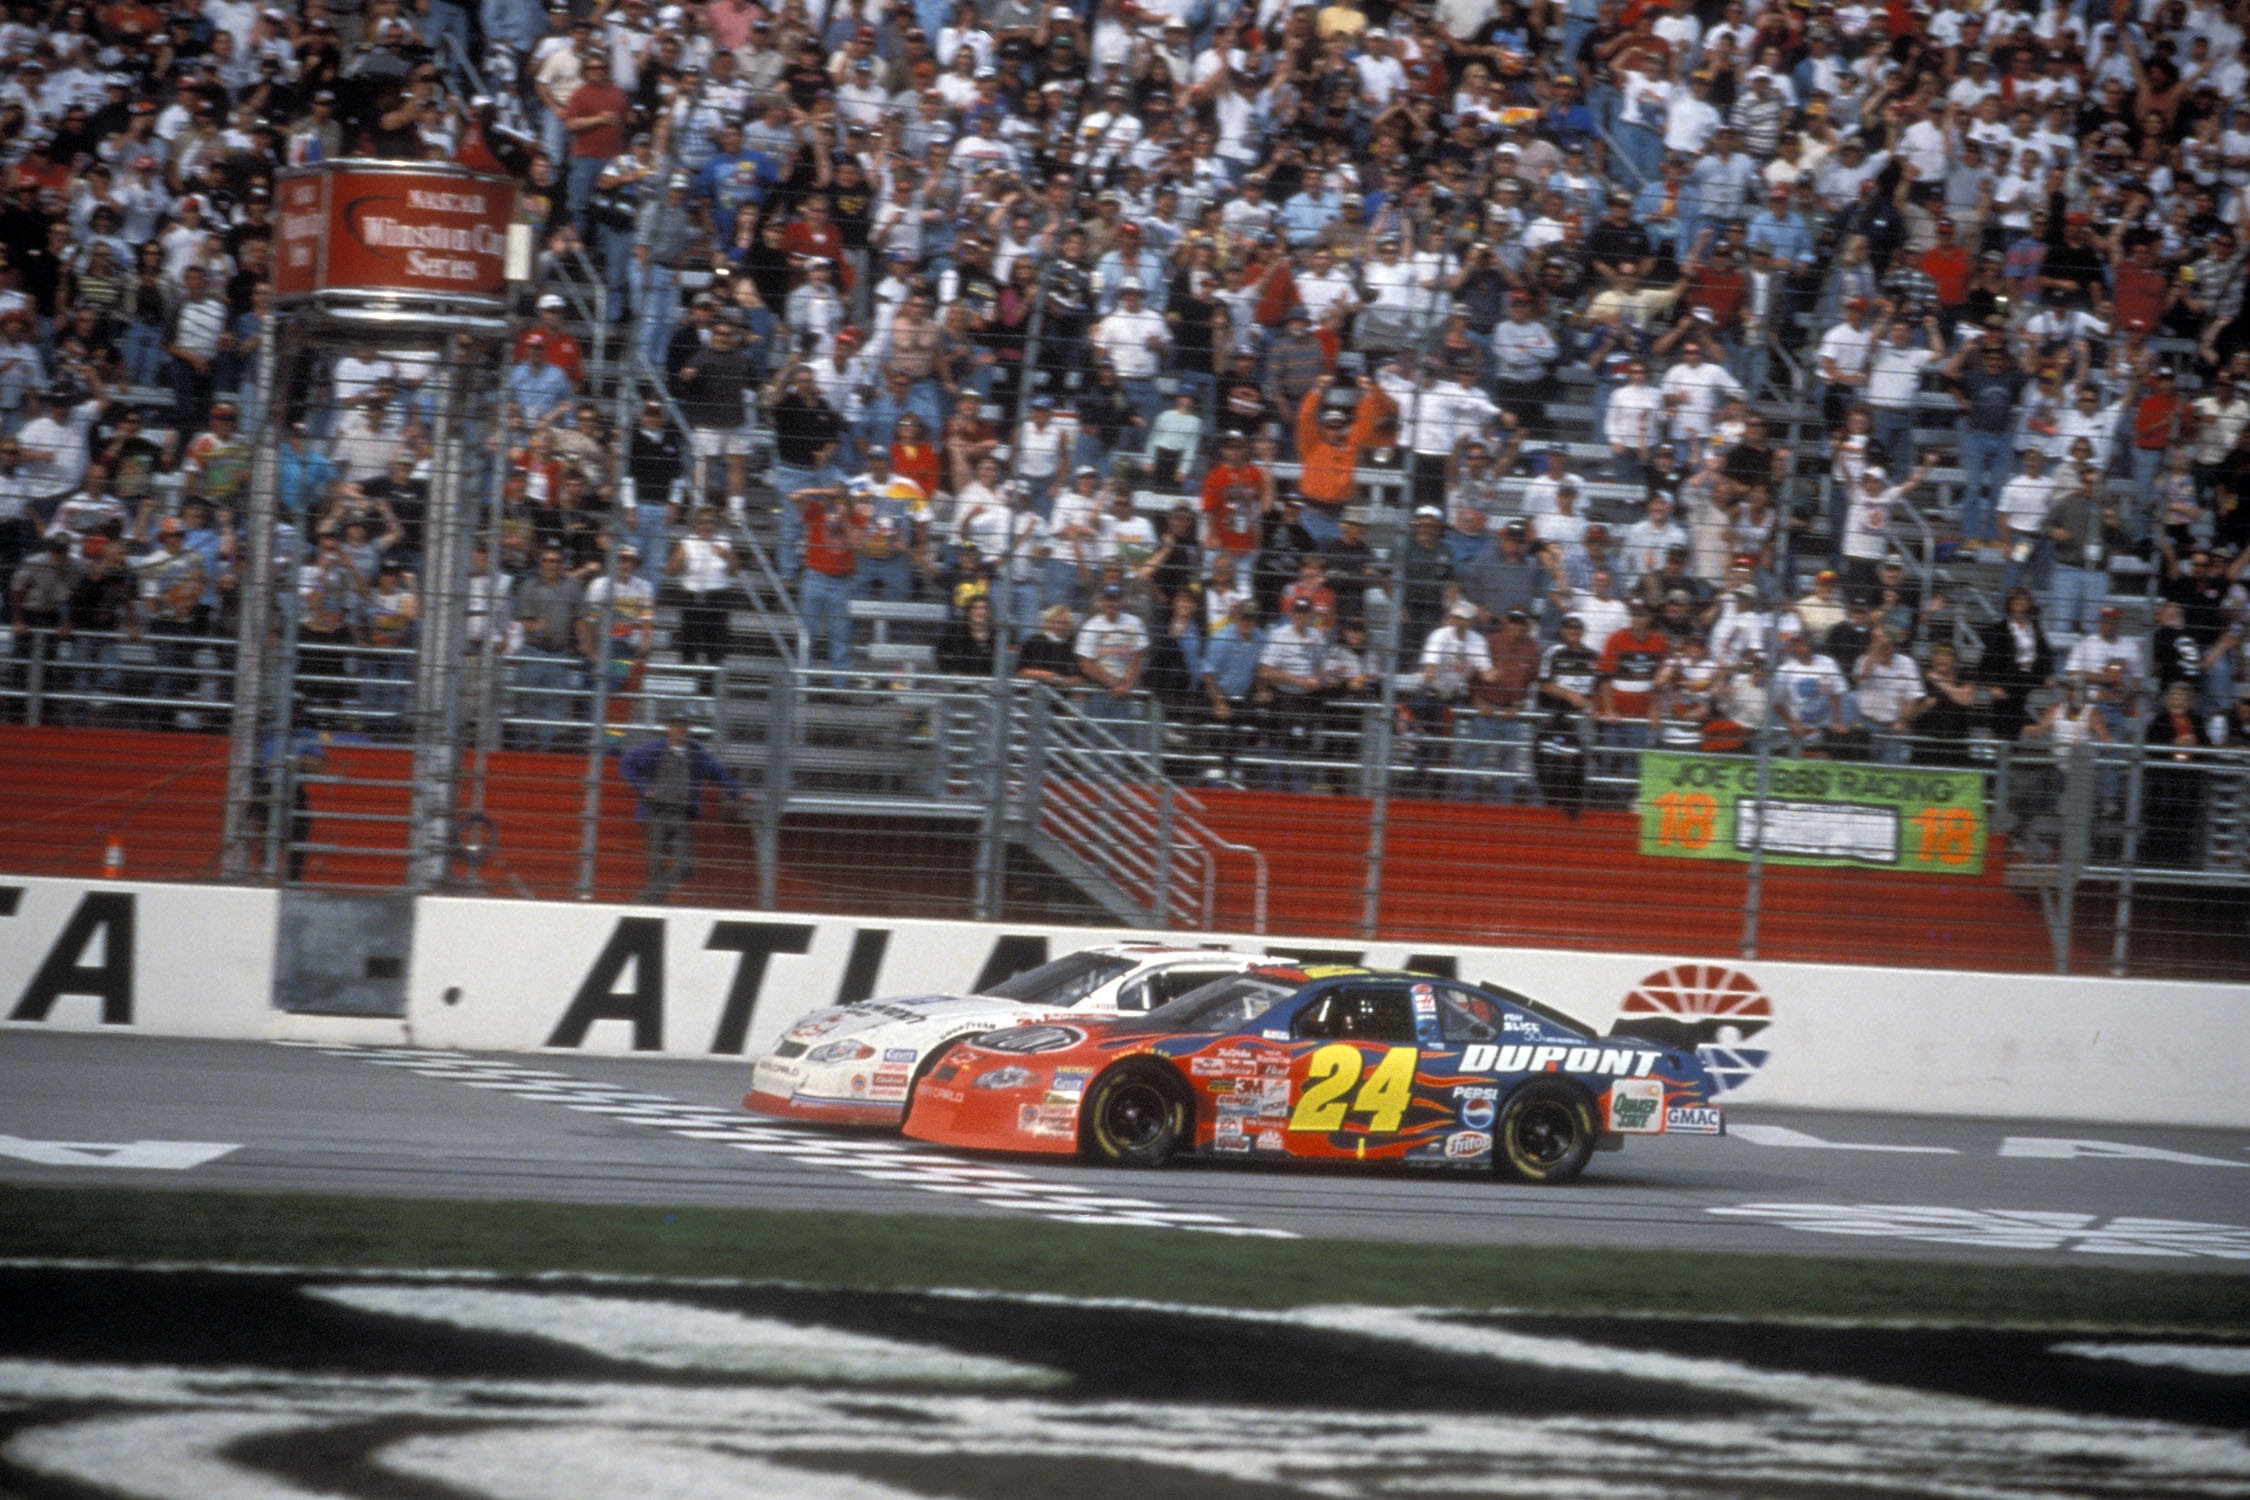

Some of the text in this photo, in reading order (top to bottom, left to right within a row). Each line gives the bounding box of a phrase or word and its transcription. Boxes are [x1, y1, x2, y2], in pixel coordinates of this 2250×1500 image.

[362, 216, 472, 251] Winston
[405, 249, 478, 281] Series
[1671, 761, 1953, 803] JOE GBBS RACING
[1653, 792, 1718, 850] 18
[1911, 807, 1976, 865] 18
[1457, 1044, 1663, 1077] DUPONT
[1288, 1044, 1418, 1131] 24
[1452, 1086, 1498, 1100] PEPSI
[1668, 1108, 1718, 1126] GMAC
[1450, 1134, 1490, 1155] Fritos
